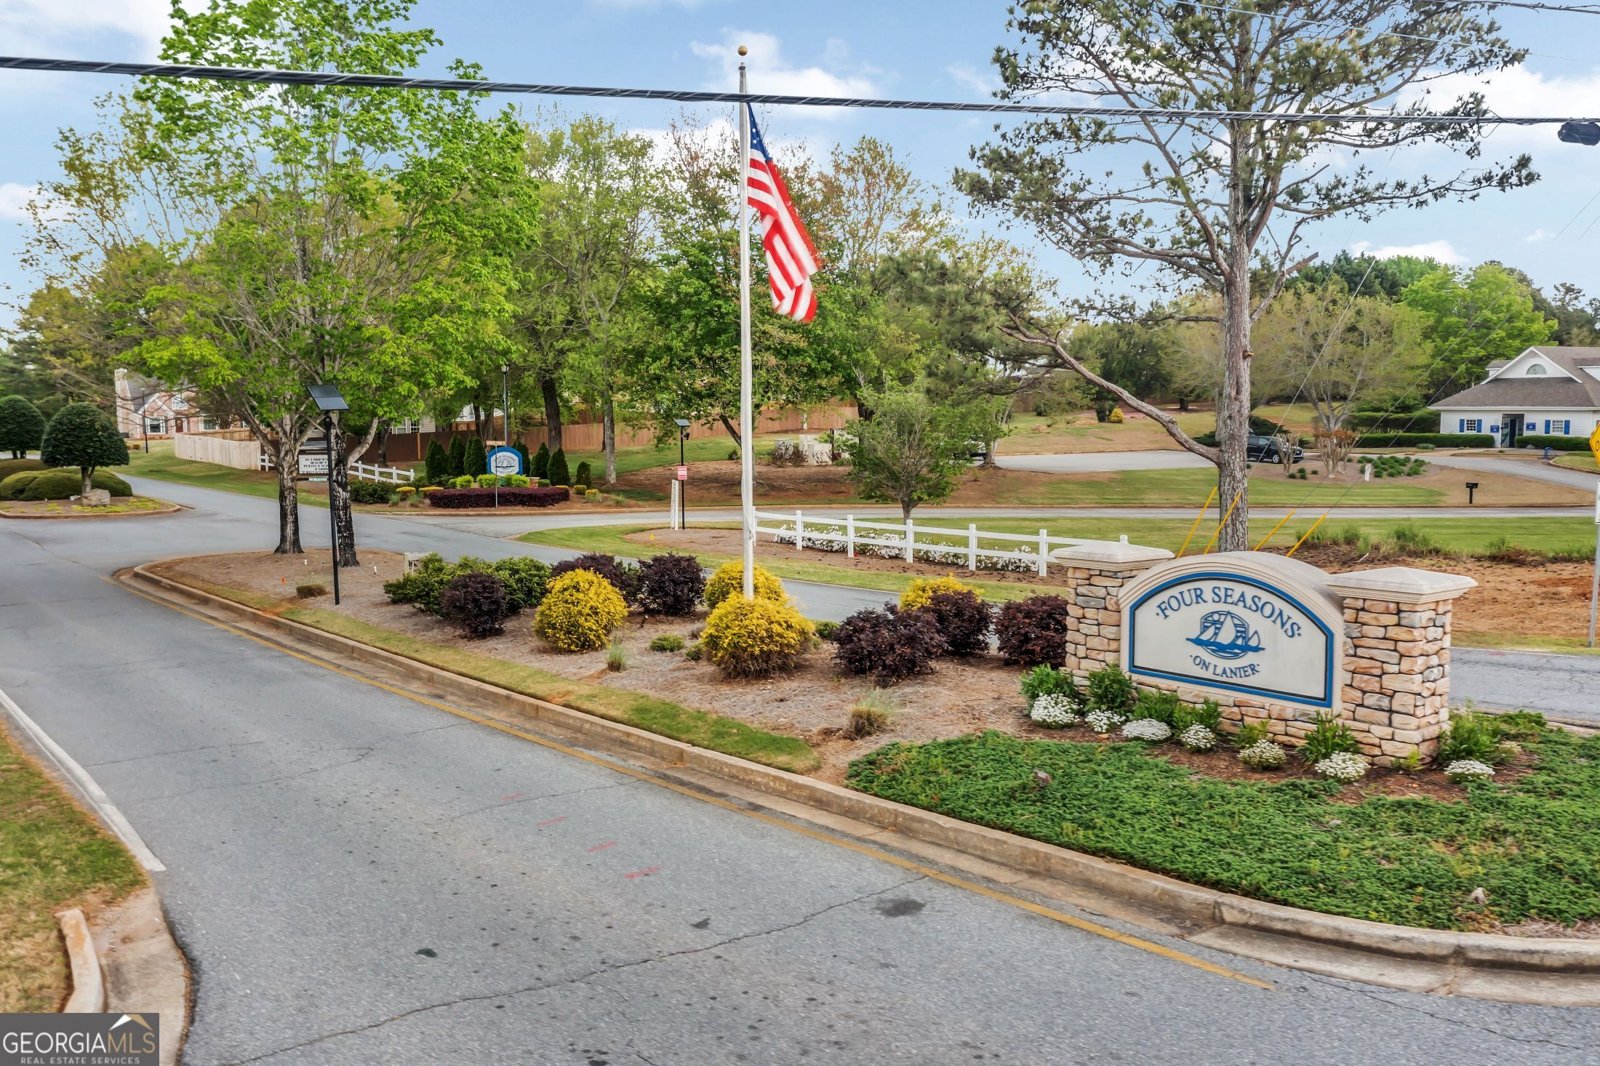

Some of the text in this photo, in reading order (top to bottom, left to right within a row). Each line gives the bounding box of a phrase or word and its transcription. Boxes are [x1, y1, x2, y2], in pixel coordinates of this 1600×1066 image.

[1156, 586, 1301, 639] FOUR SEASONS
[1193, 655, 1260, 679] ON LANIER
